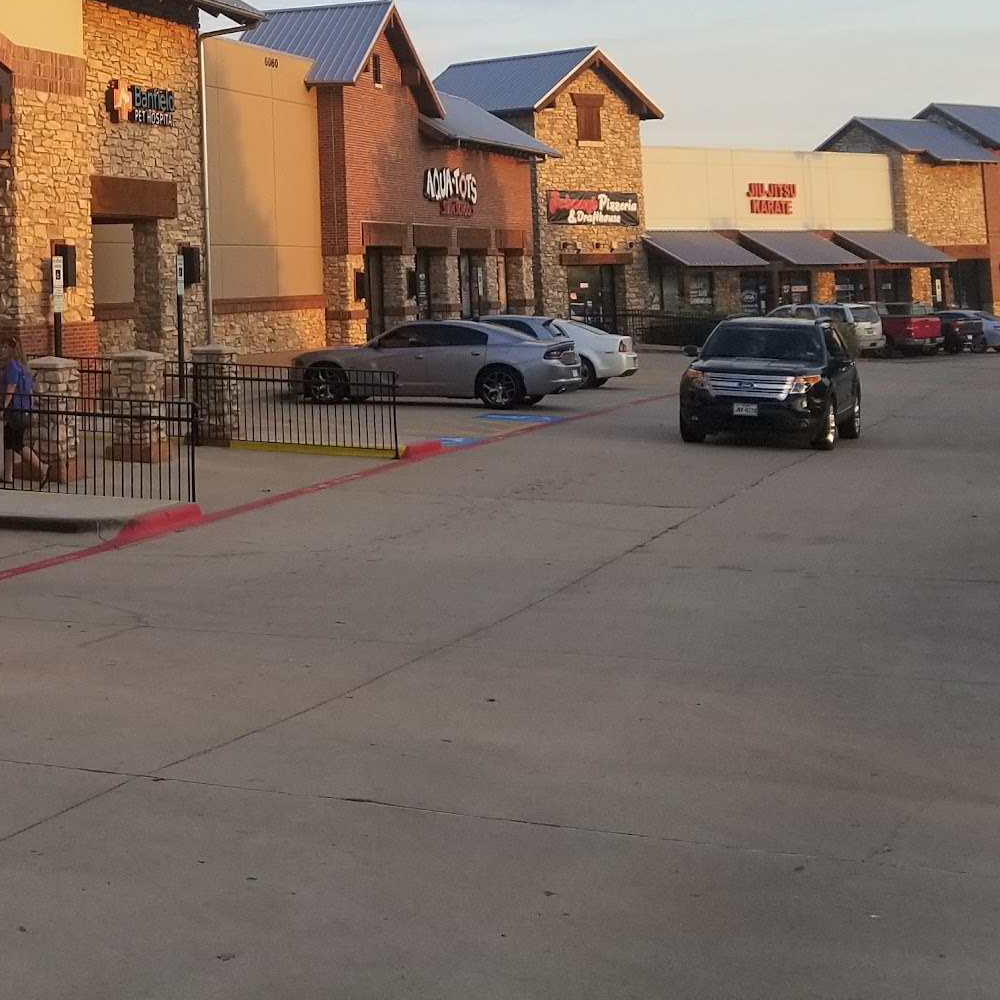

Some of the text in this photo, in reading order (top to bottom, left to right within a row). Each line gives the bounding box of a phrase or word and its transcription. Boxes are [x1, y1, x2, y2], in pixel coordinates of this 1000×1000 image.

[134, 85, 175, 112] Banfield
[134, 109, 146, 122] PET
[598, 193, 638, 212] Pizzeria
[750, 199, 793, 214] KARATE
[577, 210, 621, 224] Drafthouse
